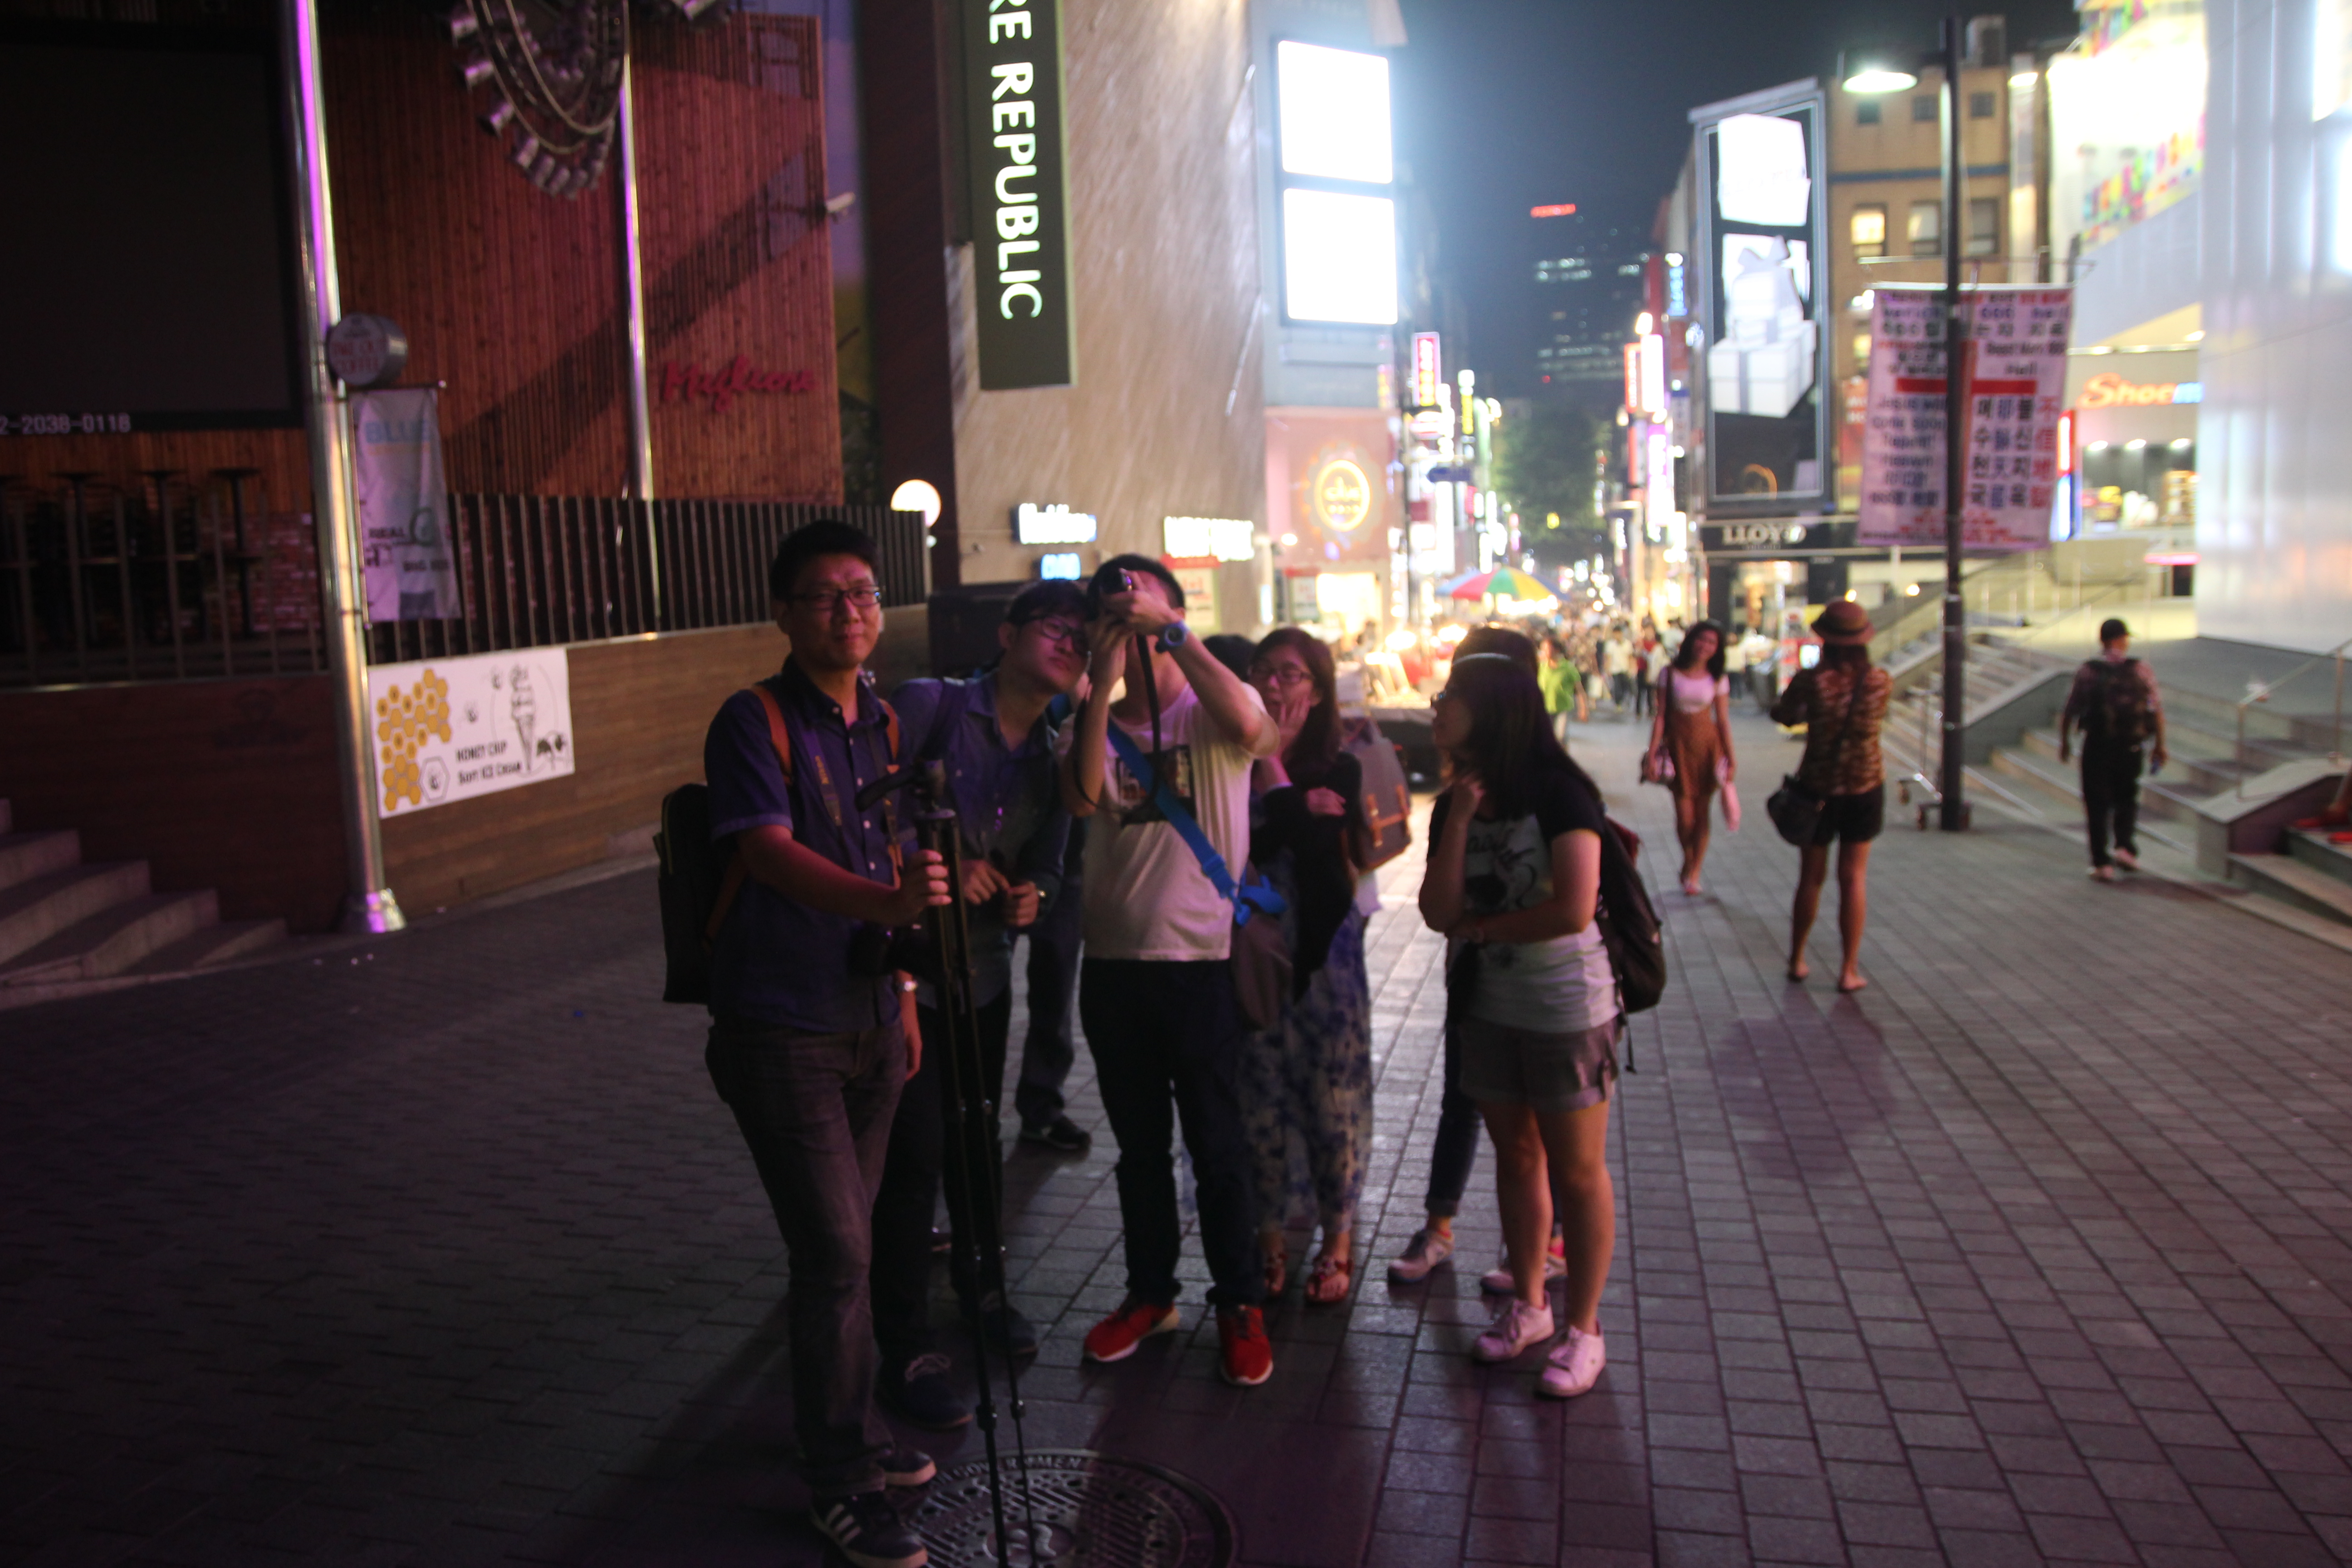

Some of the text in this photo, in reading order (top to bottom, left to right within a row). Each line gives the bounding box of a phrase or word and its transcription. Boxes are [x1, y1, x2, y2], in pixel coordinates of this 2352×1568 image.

[991, 62, 1044, 320] REPUBLIC
[1722, 523, 1807, 544] LLOYD
[456, 740, 507, 762] HONEY CHIP
[952, 1455, 1093, 1478] GOVRNMEN
